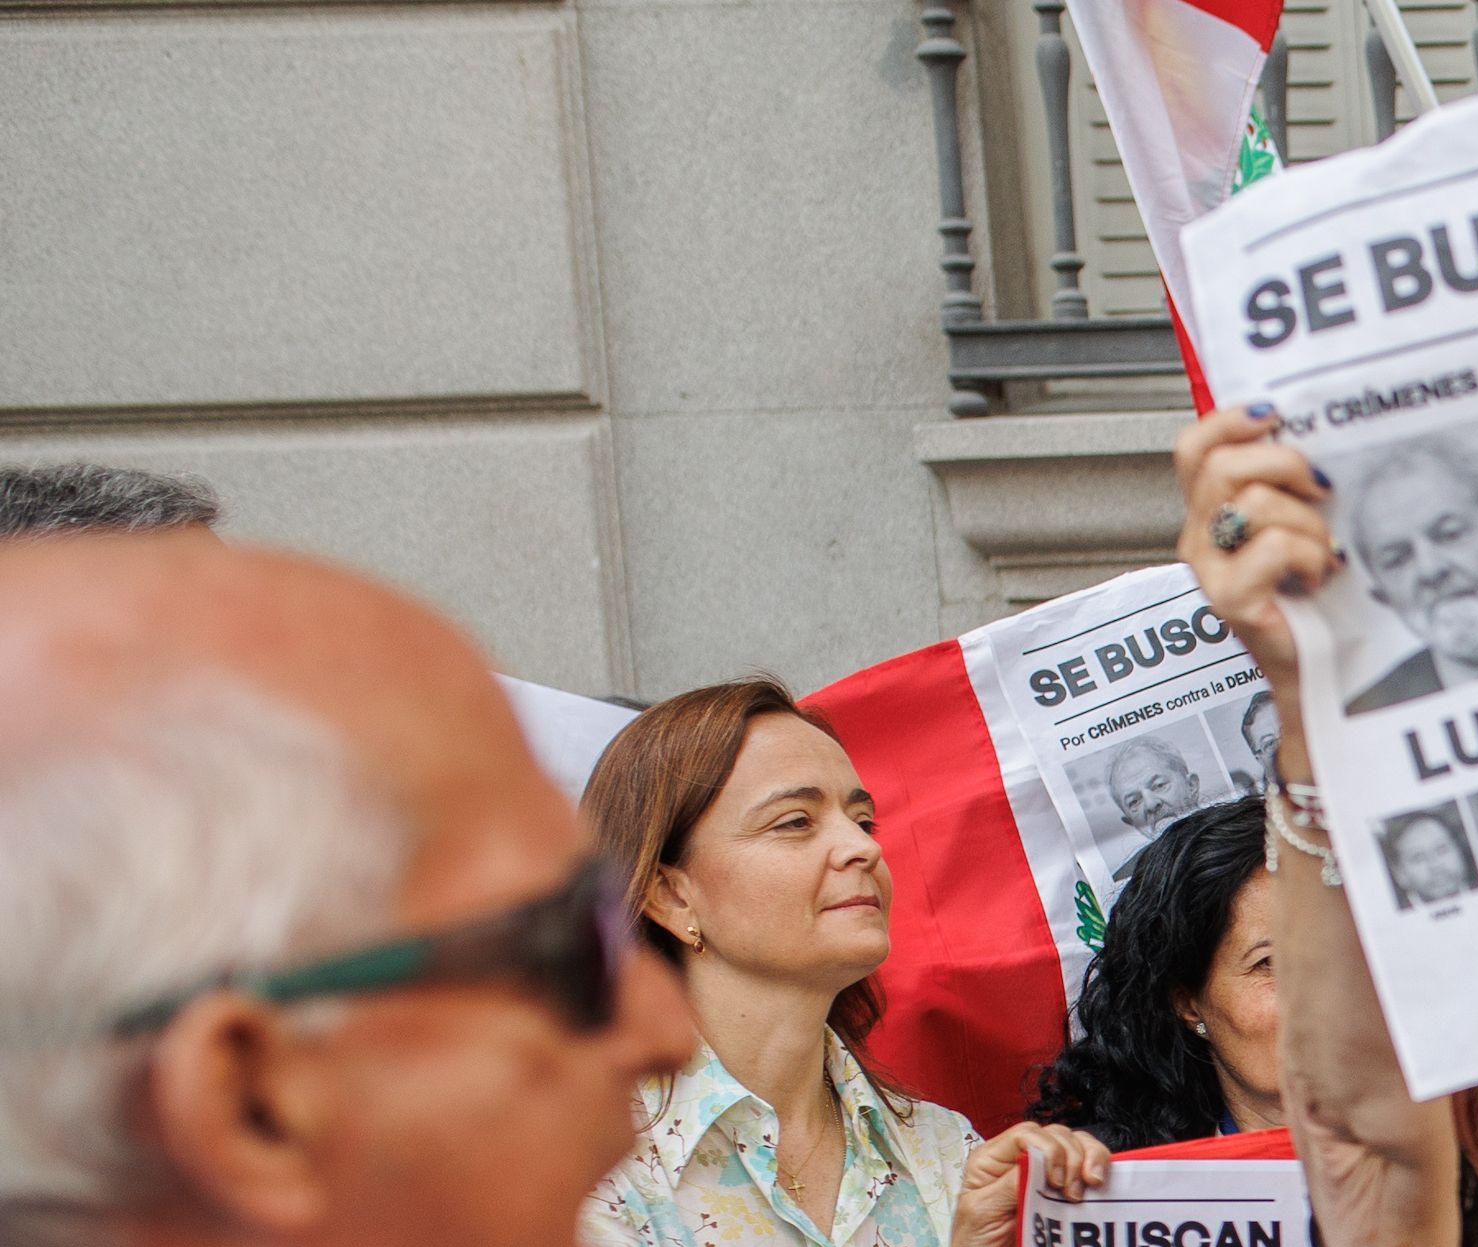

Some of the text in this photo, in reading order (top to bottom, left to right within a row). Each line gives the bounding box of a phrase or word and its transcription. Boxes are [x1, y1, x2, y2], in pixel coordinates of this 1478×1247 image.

[1246, 254, 1356, 349] SE
[1325, 370, 1478, 426] CRÍMENES
[1030, 605, 1236, 707] SE BUSC
[1061, 667, 1265, 751] Por CRÍMENES contra la DEMO
